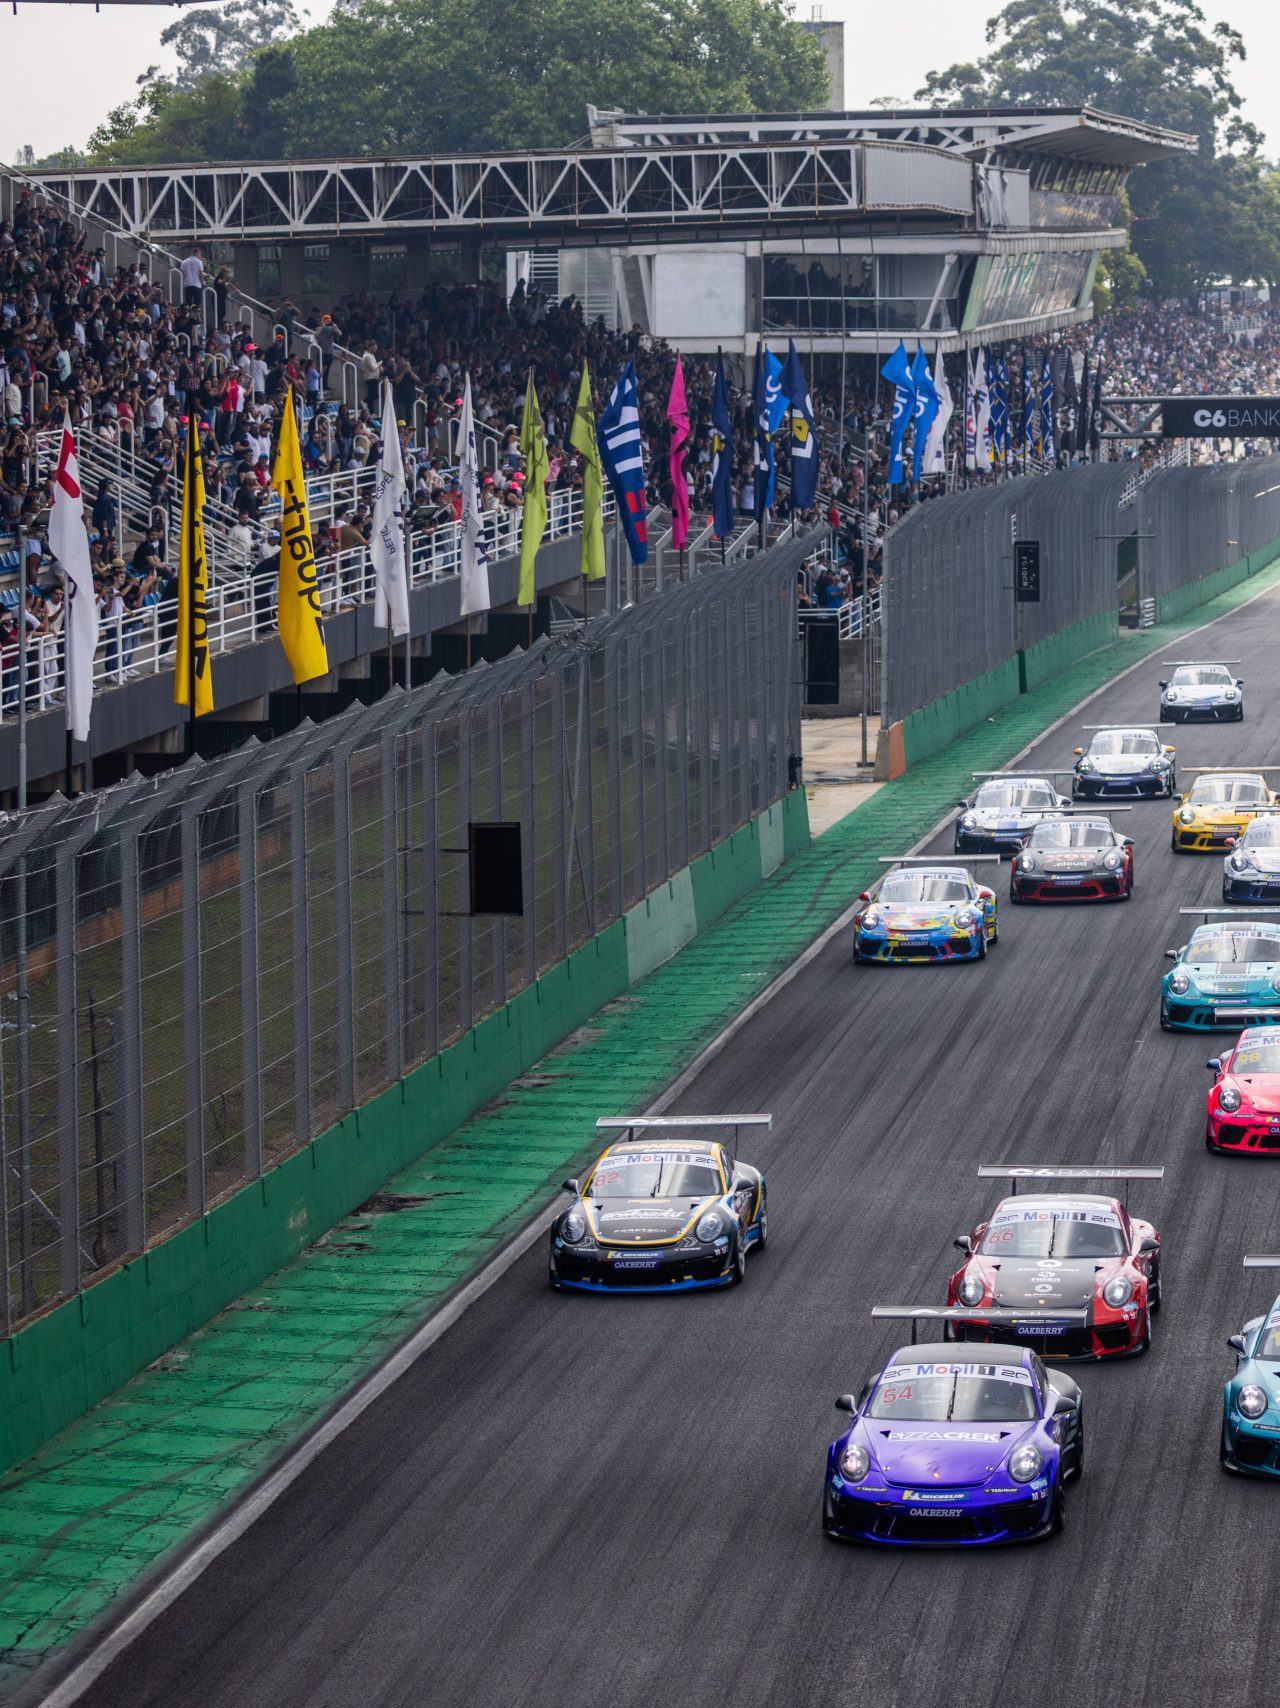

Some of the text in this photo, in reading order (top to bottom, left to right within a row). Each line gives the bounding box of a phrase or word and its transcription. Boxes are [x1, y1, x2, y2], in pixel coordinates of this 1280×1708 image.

[1194, 409, 1280, 427] C6BANK
[627, 1155, 673, 1163] Mobil
[595, 1171, 620, 1186] 82
[1024, 1212, 1070, 1221] Mobil
[989, 1231, 1014, 1244] 66
[615, 1260, 657, 1268] OAKBERRY
[1019, 1326, 1063, 1335] OAKBERRY
[917, 1364, 975, 1375] Mobil
[882, 1386, 913, 1404] 54
[889, 1432, 999, 1441] PIZZACREK
[910, 1508, 964, 1517] OAKBERRY
